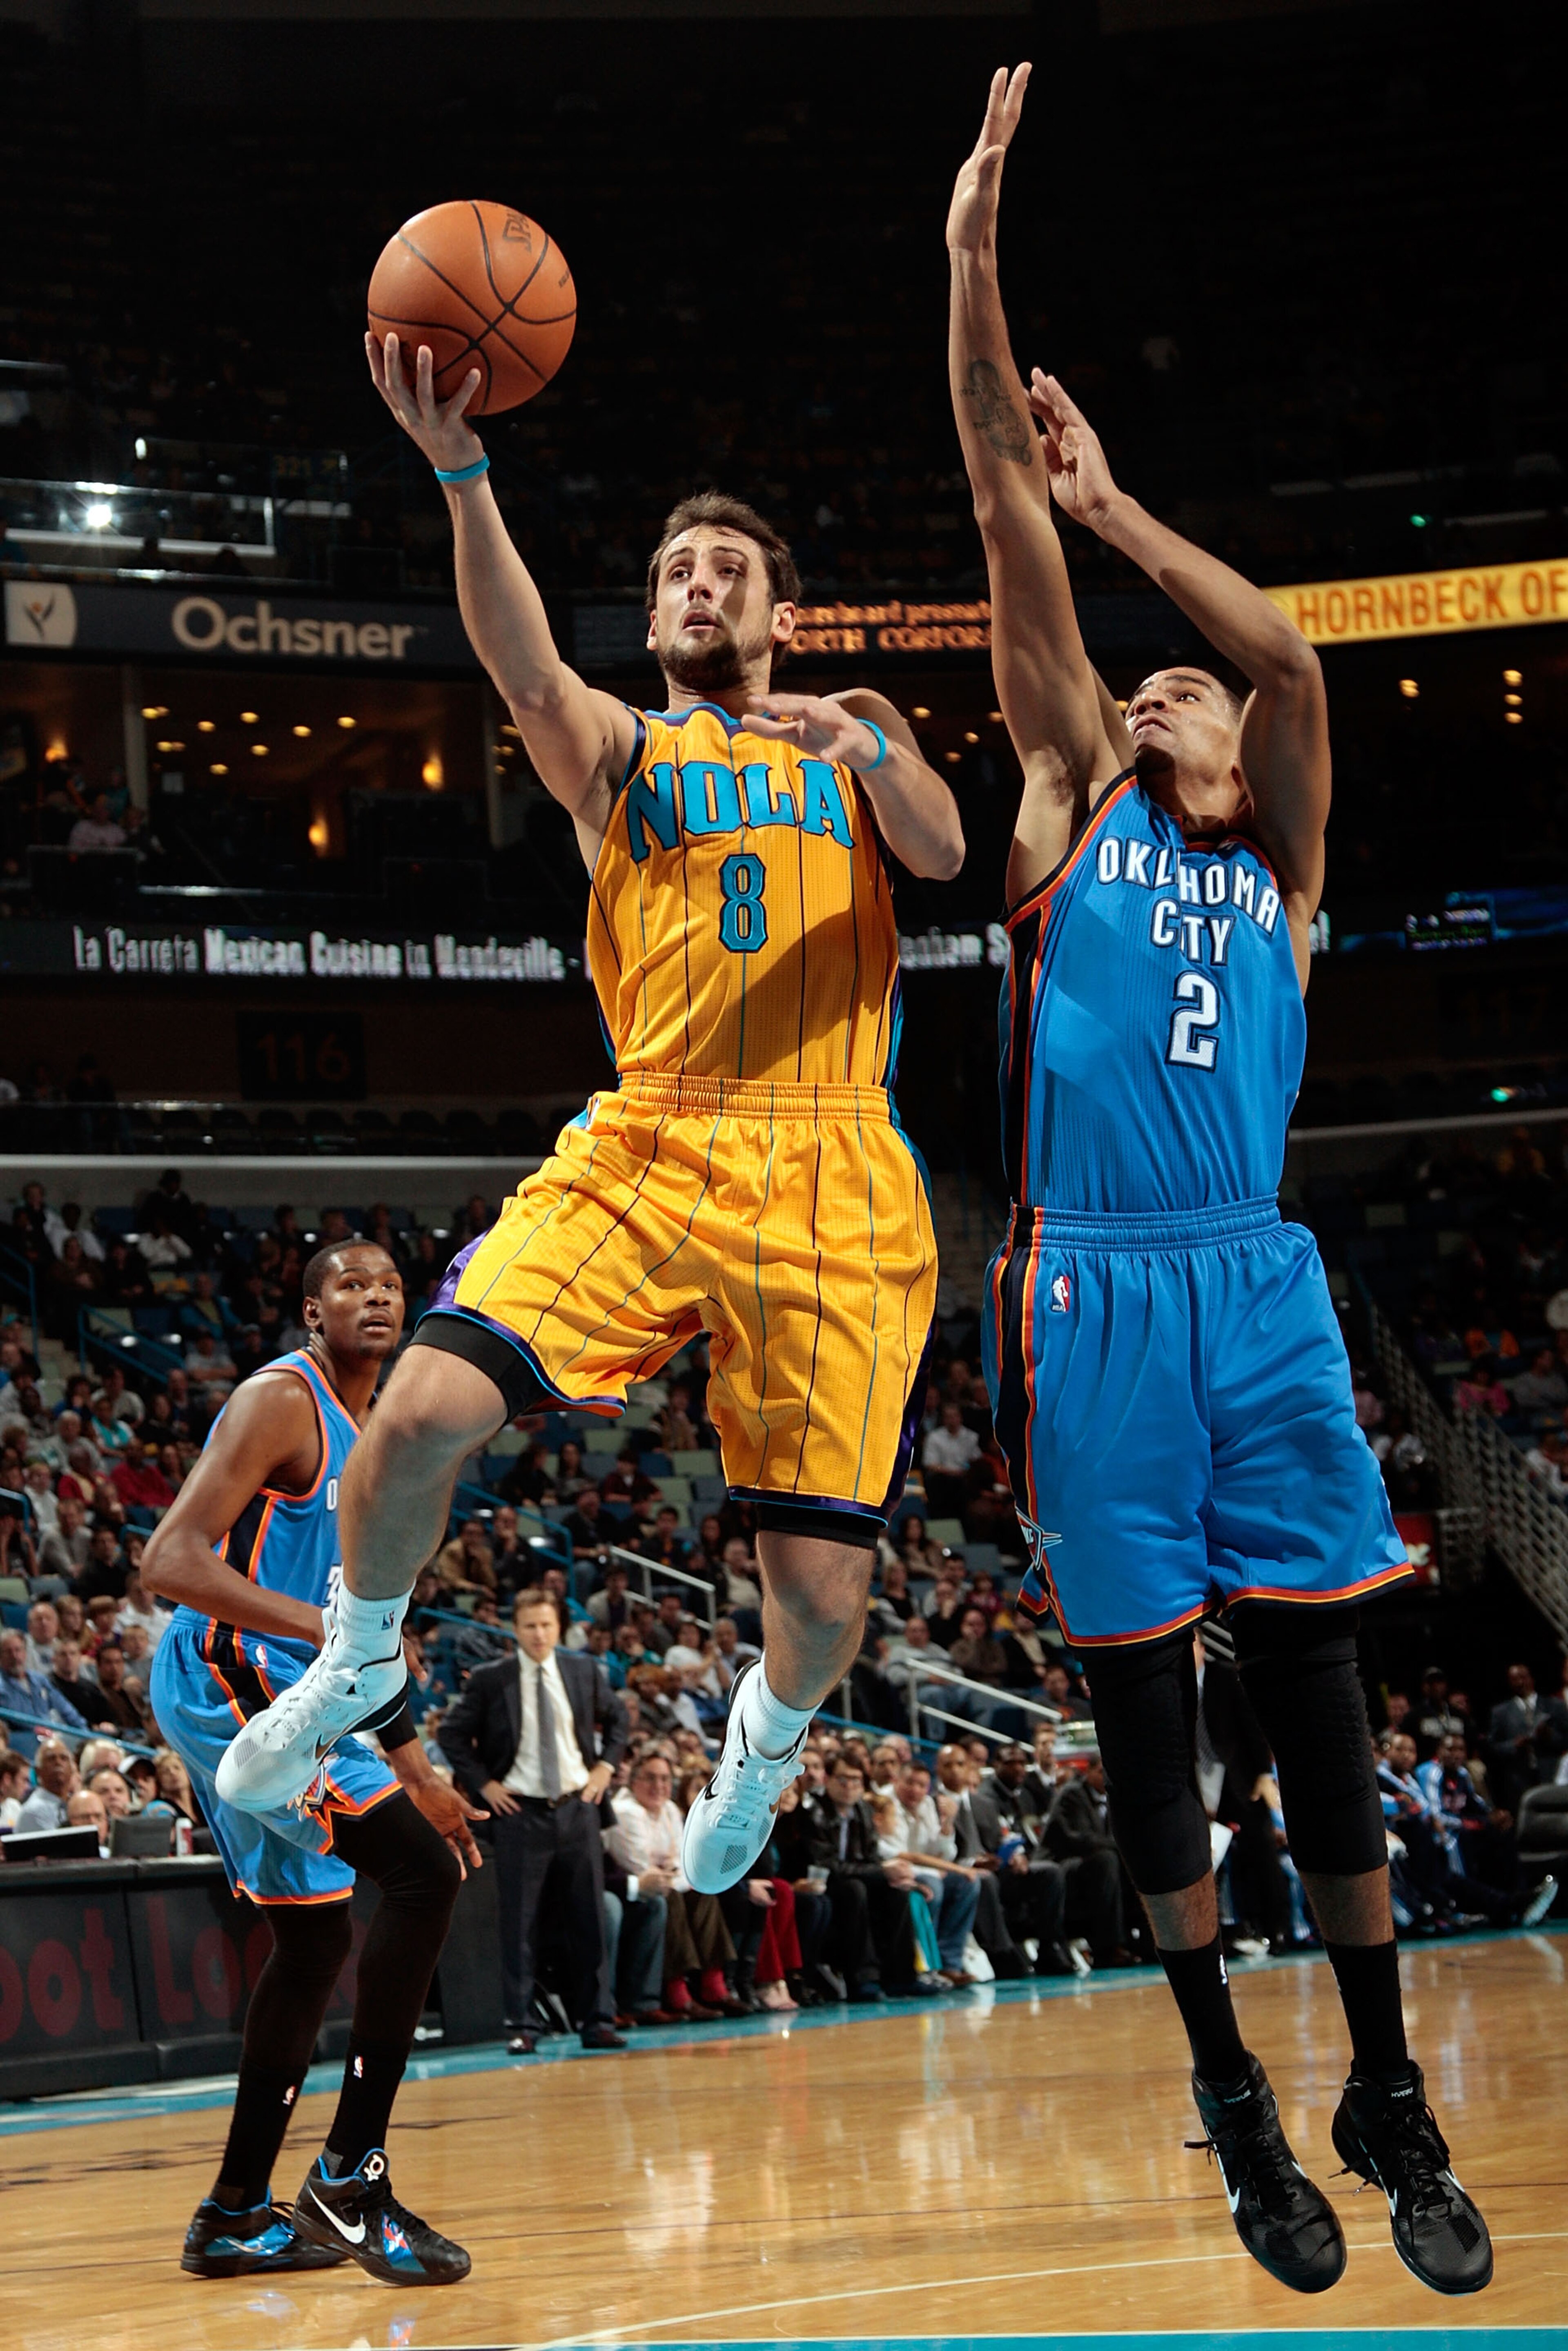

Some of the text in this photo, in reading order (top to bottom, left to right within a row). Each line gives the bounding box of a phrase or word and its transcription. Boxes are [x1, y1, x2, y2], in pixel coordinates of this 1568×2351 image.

[172, 596, 412, 657] Ochsner
[1296, 574, 1508, 635] HORNBECK
[627, 759, 856, 864] NOLA
[718, 853, 768, 953] 8
[1097, 836, 1282, 937] OKLHOMA
[73, 925, 101, 971] La
[204, 927, 307, 976] Mexican
[310, 931, 402, 978] Cuisine
[1165, 970, 1221, 1074] 2
